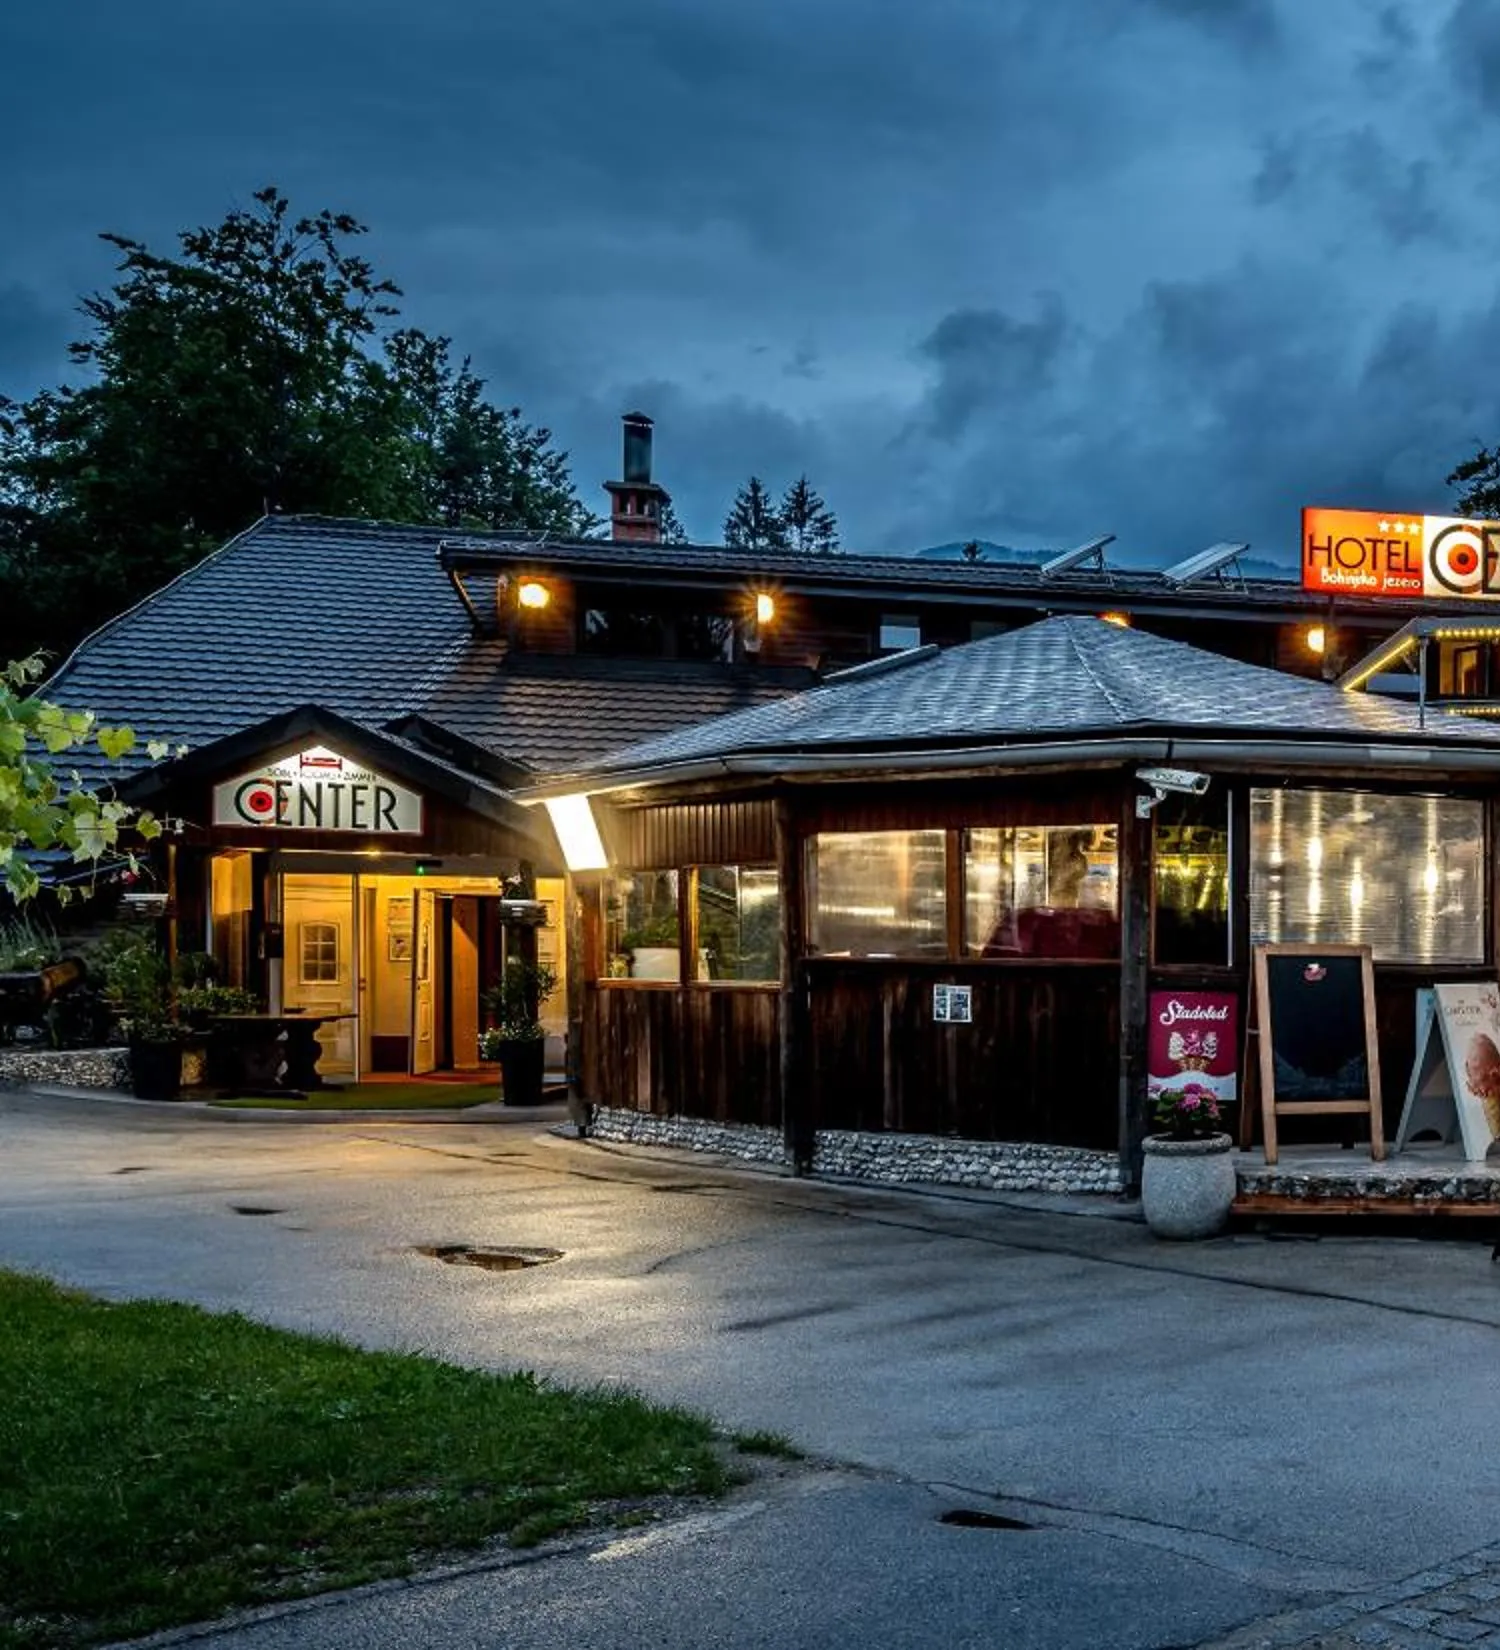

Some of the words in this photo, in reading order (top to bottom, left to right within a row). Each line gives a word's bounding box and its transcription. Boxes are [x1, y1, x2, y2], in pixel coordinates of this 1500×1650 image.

[1308, 533, 1419, 573] HOTEL
[1381, 571, 1421, 592] jezero
[234, 777, 399, 831] CENTER
